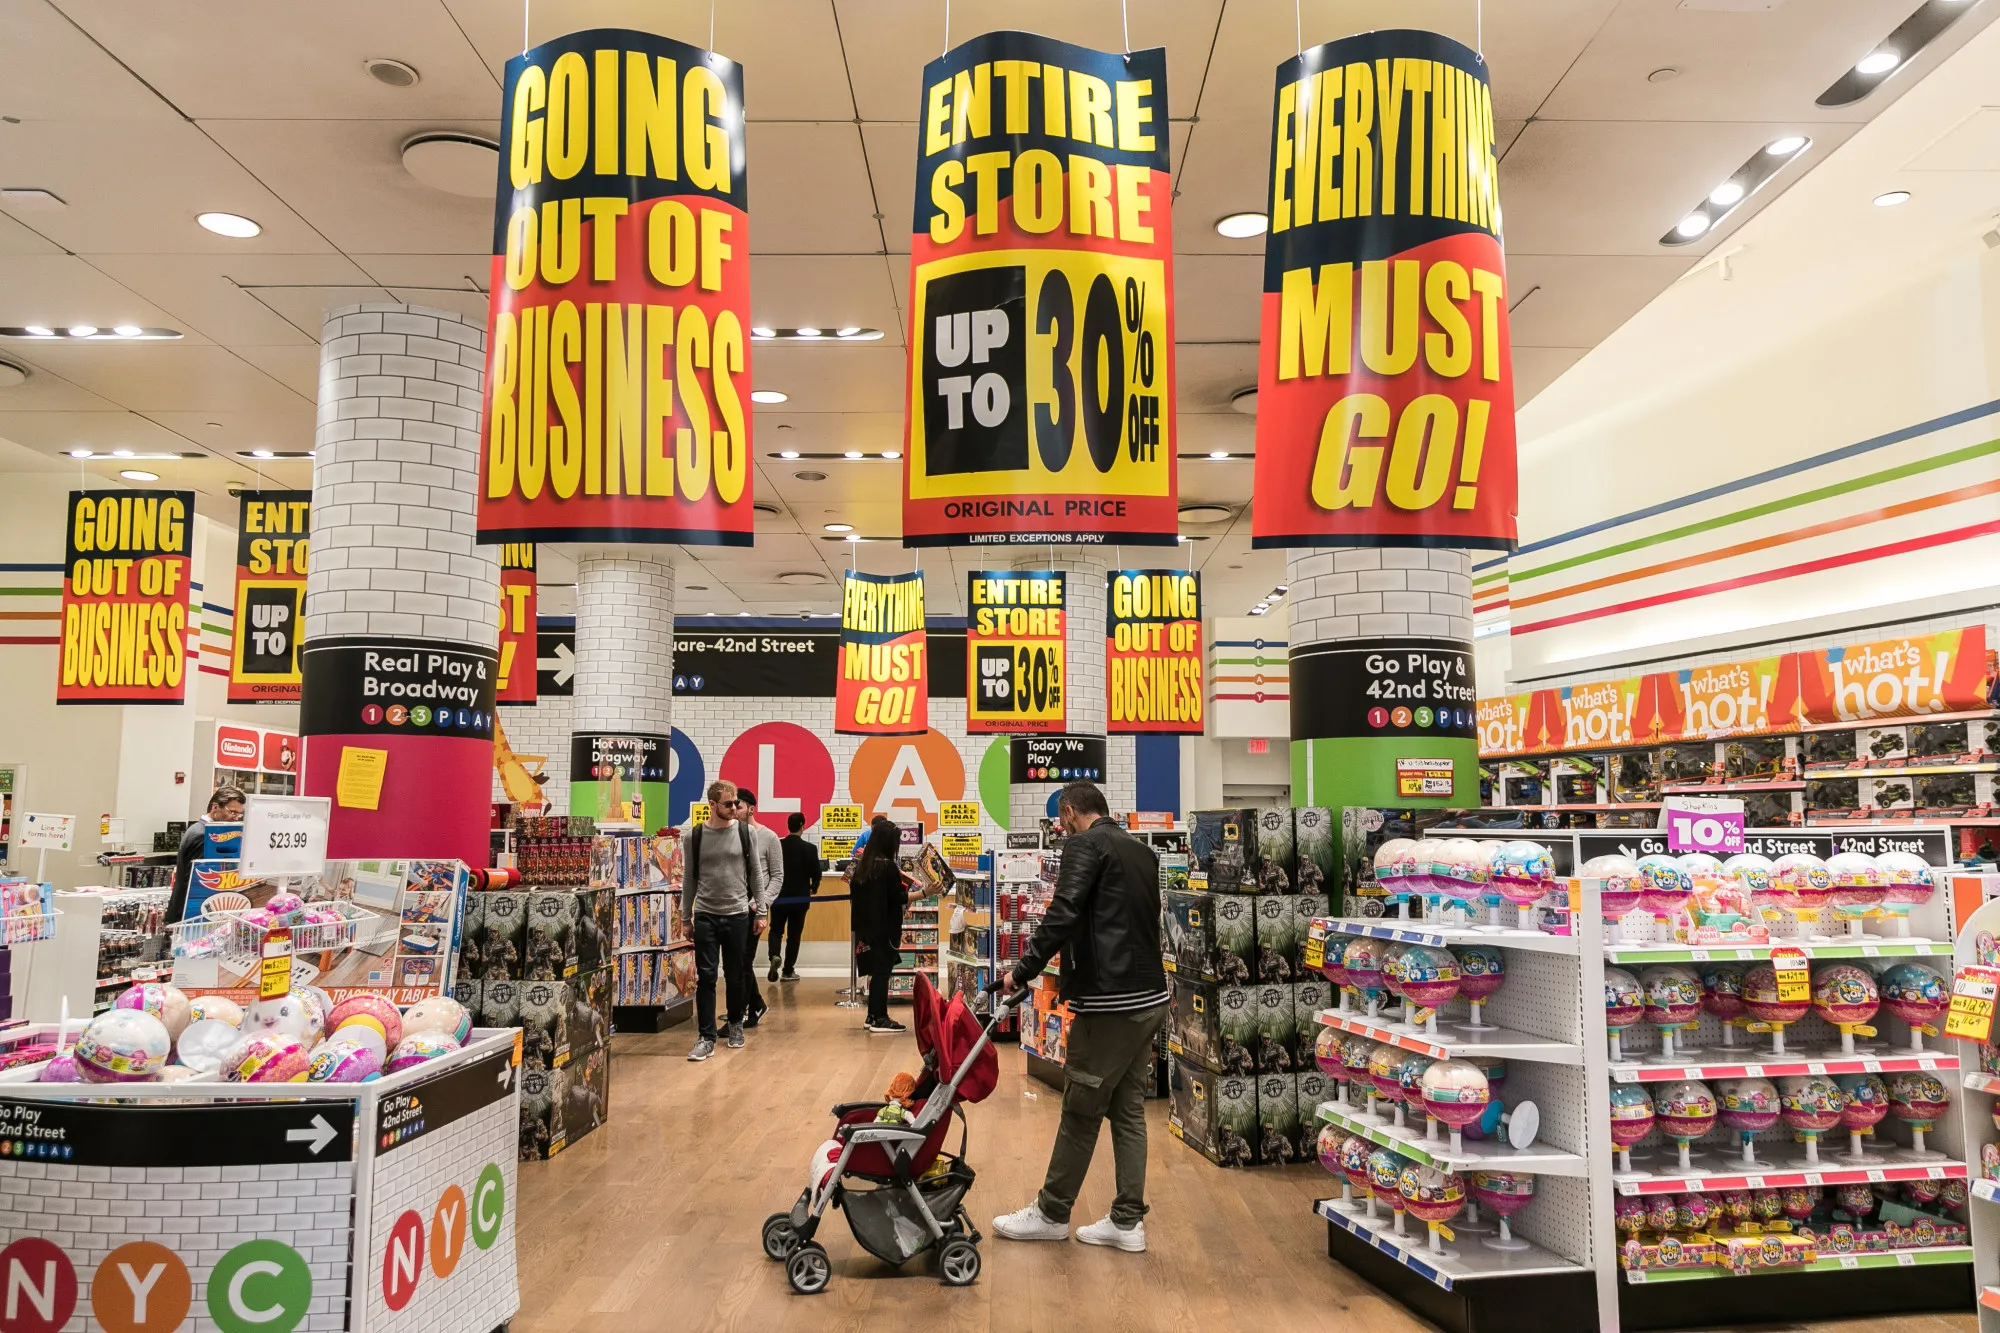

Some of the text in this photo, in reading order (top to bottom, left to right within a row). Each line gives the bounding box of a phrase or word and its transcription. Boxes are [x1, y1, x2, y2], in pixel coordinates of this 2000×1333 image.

[509, 48, 732, 194] GOING
[925, 60, 1156, 157] ENTIRE
[929, 149, 1155, 245] STORE
[504, 197, 733, 291] OUT OF
[1279, 259, 1503, 382] MUST
[935, 309, 1010, 368] UP
[488, 299, 745, 504] BUSINESS
[937, 372, 1160, 464] TO OFF
[1311, 393, 1491, 510] GO!
[944, 500, 1126, 518] ORIGINAL PRICE
[74, 497, 185, 552] GOING
[969, 533, 1105, 545] LIMITED EXCEPTIONS APPLY
[72, 558, 183, 596] OUT OF
[843, 577, 924, 633] EVERYTHING
[972, 579, 1062, 605] ENTIRE
[1113, 574, 1197, 618] GOING
[252, 604, 289, 628] UP
[976, 607, 1060, 636] STORE
[63, 602, 185, 687] BUSINESS
[252, 631, 286, 656] TO
[761, 638, 814, 653] Street
[1114, 622, 1197, 652] OUT OF
[364, 652, 419, 673] Real
[428, 655, 473, 682] Play
[476, 661, 487, 680] &
[844, 641, 924, 682] MUST
[981, 658, 1010, 677] UP
[1365, 654, 1466, 680] Go Play &
[1844, 640, 1921, 676] what's
[363, 676, 479, 707] Broadway
[982, 679, 1010, 698] TO
[1111, 656, 1202, 722] BUSINESS
[1366, 679, 1475, 702] 42nd Street
[1691, 665, 1750, 695] what's
[1828, 651, 1949, 722] hot!
[855, 686, 917, 725] GO!
[1476, 699, 1513, 722] what's
[1571, 684, 1618, 710] what's
[1680, 675, 1771, 737] hot!
[1562, 692, 1635, 748] hot!
[223, 742, 253, 754] Nintendo
[592, 739, 657, 751] Hot Wheels
[592, 751, 648, 765] Dragway
[1027, 740, 1084, 754] Today We
[1249, 739, 1269, 753] EXIT
[48, 830, 66, 839] here!
[269, 832, 308, 850] $23.99
[1640, 838, 1663, 853] Go
[1766, 839, 1816, 854] Street
[1724, 835, 1741, 847] OFF
[1840, 838, 1924, 853] 42nd Street
[14, 1106, 42, 1124] Play
[382, 1103, 423, 1129] 42nd Street
[383, 1095, 412, 1113] Go Play
[25, 1123, 66, 1139] Street
